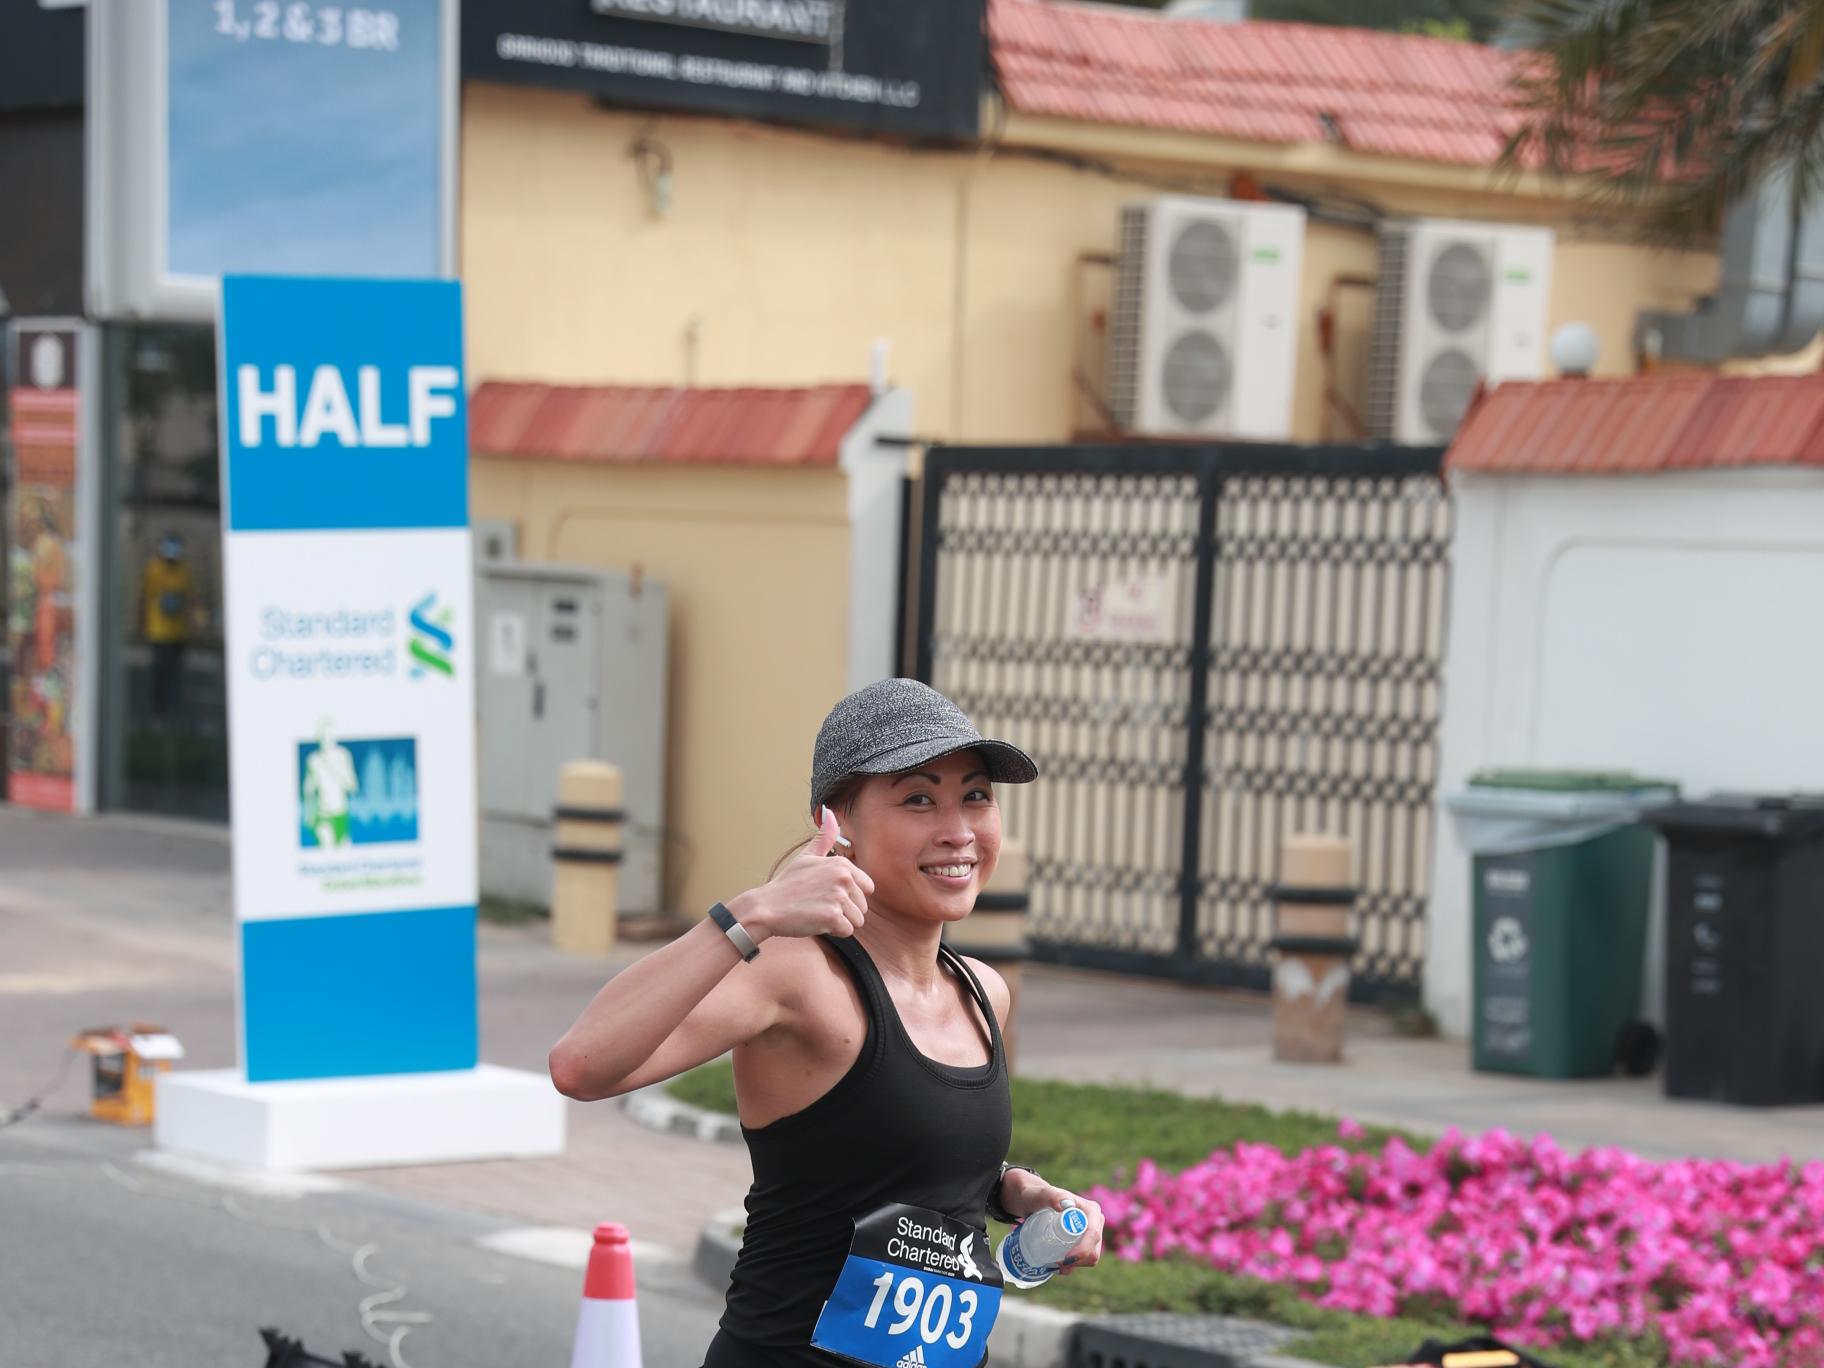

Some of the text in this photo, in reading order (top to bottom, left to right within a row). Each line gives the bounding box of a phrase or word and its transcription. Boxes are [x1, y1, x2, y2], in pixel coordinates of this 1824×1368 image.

[346, 8, 400, 51] BR
[236, 363, 460, 449] HALF
[260, 605, 396, 640] Standard
[250, 645, 396, 680] Chartered
[887, 1237, 960, 1271] Chartered
[863, 1271, 979, 1350] 1903
